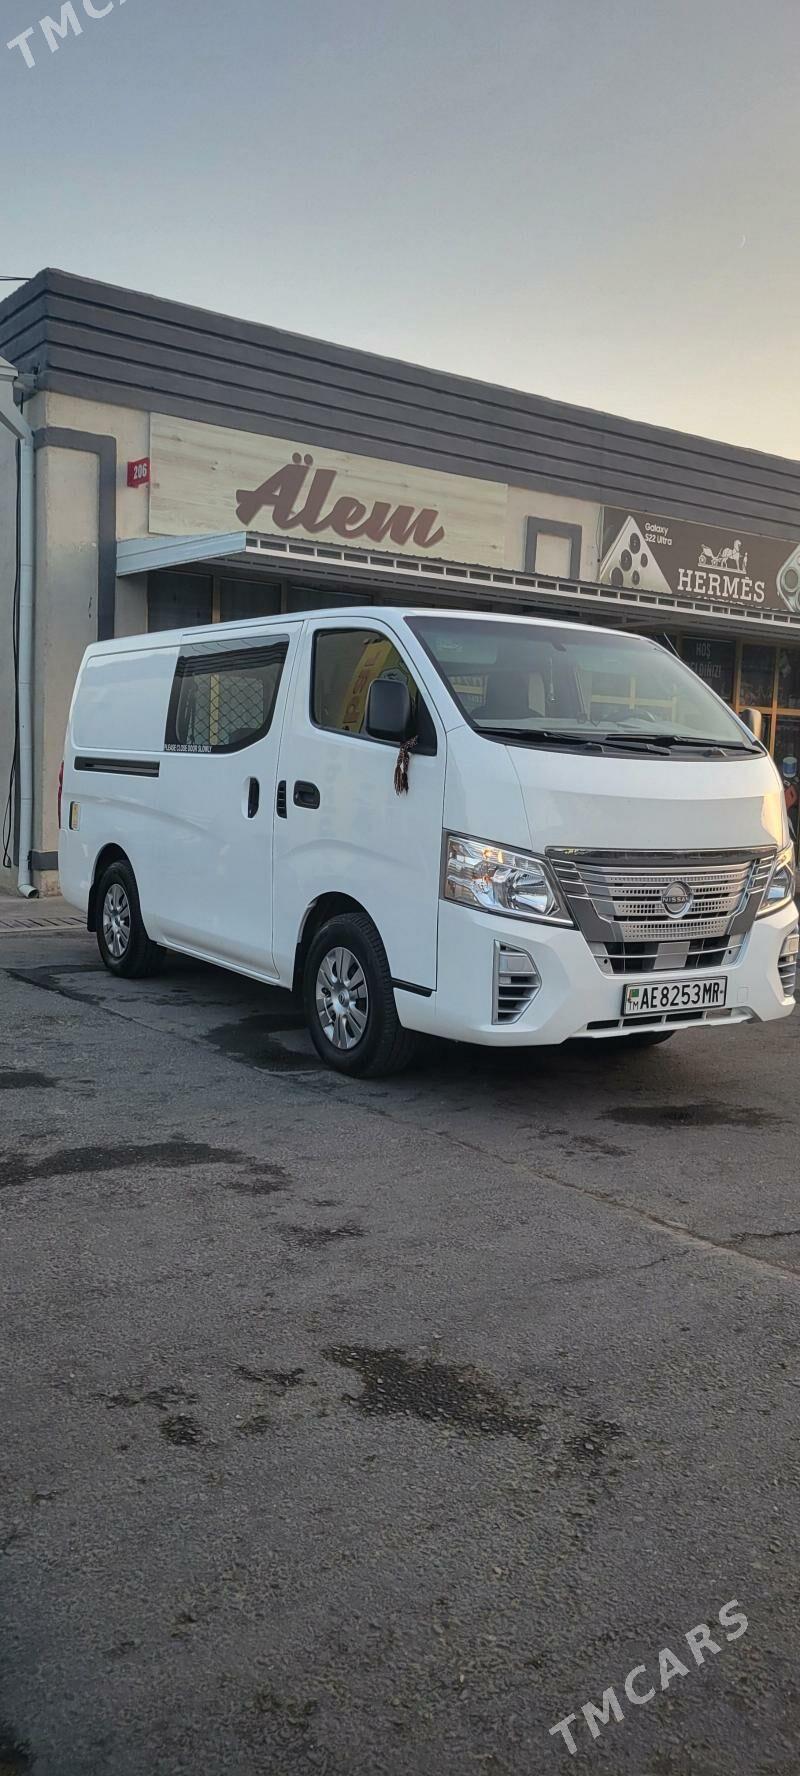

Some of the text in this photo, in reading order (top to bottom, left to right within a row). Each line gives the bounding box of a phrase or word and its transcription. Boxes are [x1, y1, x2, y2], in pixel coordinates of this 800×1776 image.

[133, 462, 148, 480] 206
[235, 452, 445, 548] Älem
[645, 522, 669, 535] Galaxy
[645, 533, 673, 546] S22 Ultra
[165, 743, 212, 753] PLEASE CLOSE DOOR SLOWLY
[639, 982, 720, 1010] AE8253MR
